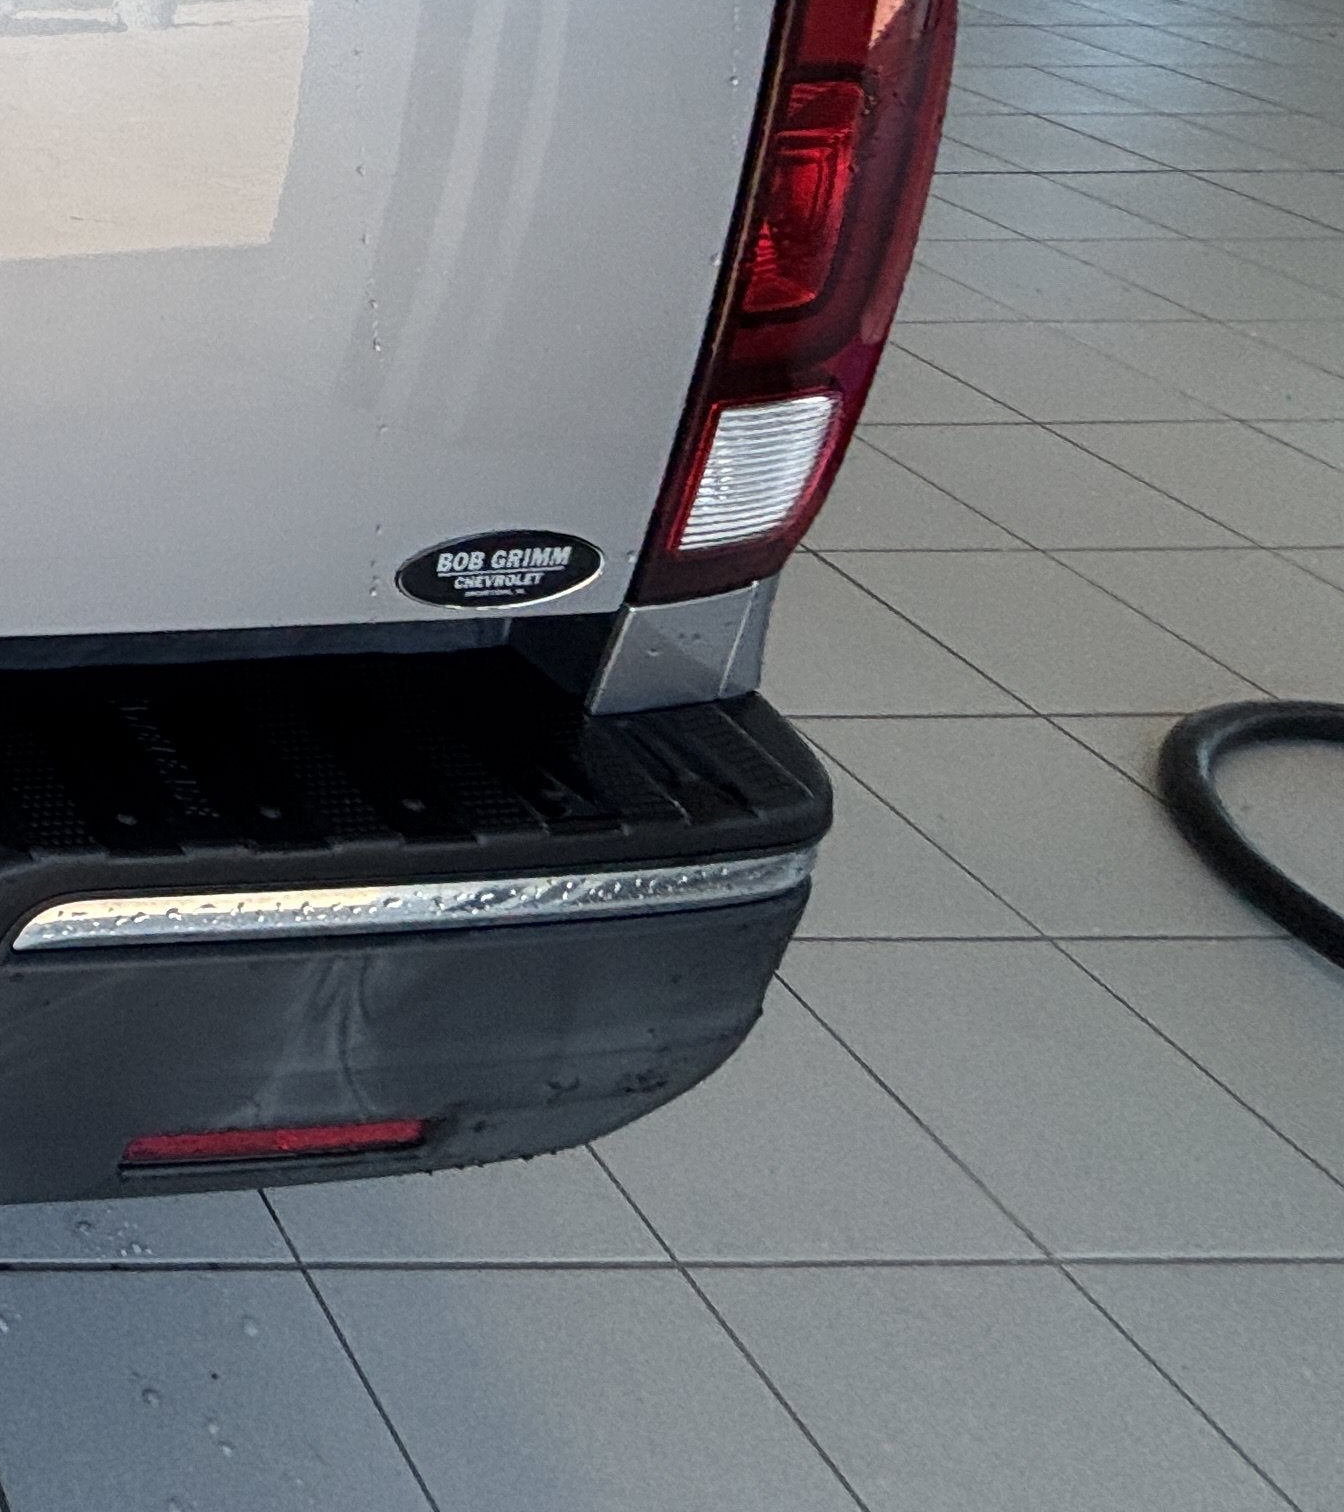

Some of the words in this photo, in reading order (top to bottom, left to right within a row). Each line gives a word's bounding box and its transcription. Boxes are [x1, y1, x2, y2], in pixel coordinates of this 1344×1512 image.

[436, 551, 485, 573] BOB
[491, 546, 572, 569] GRIMM
[454, 572, 545, 590] CHEVROLET
